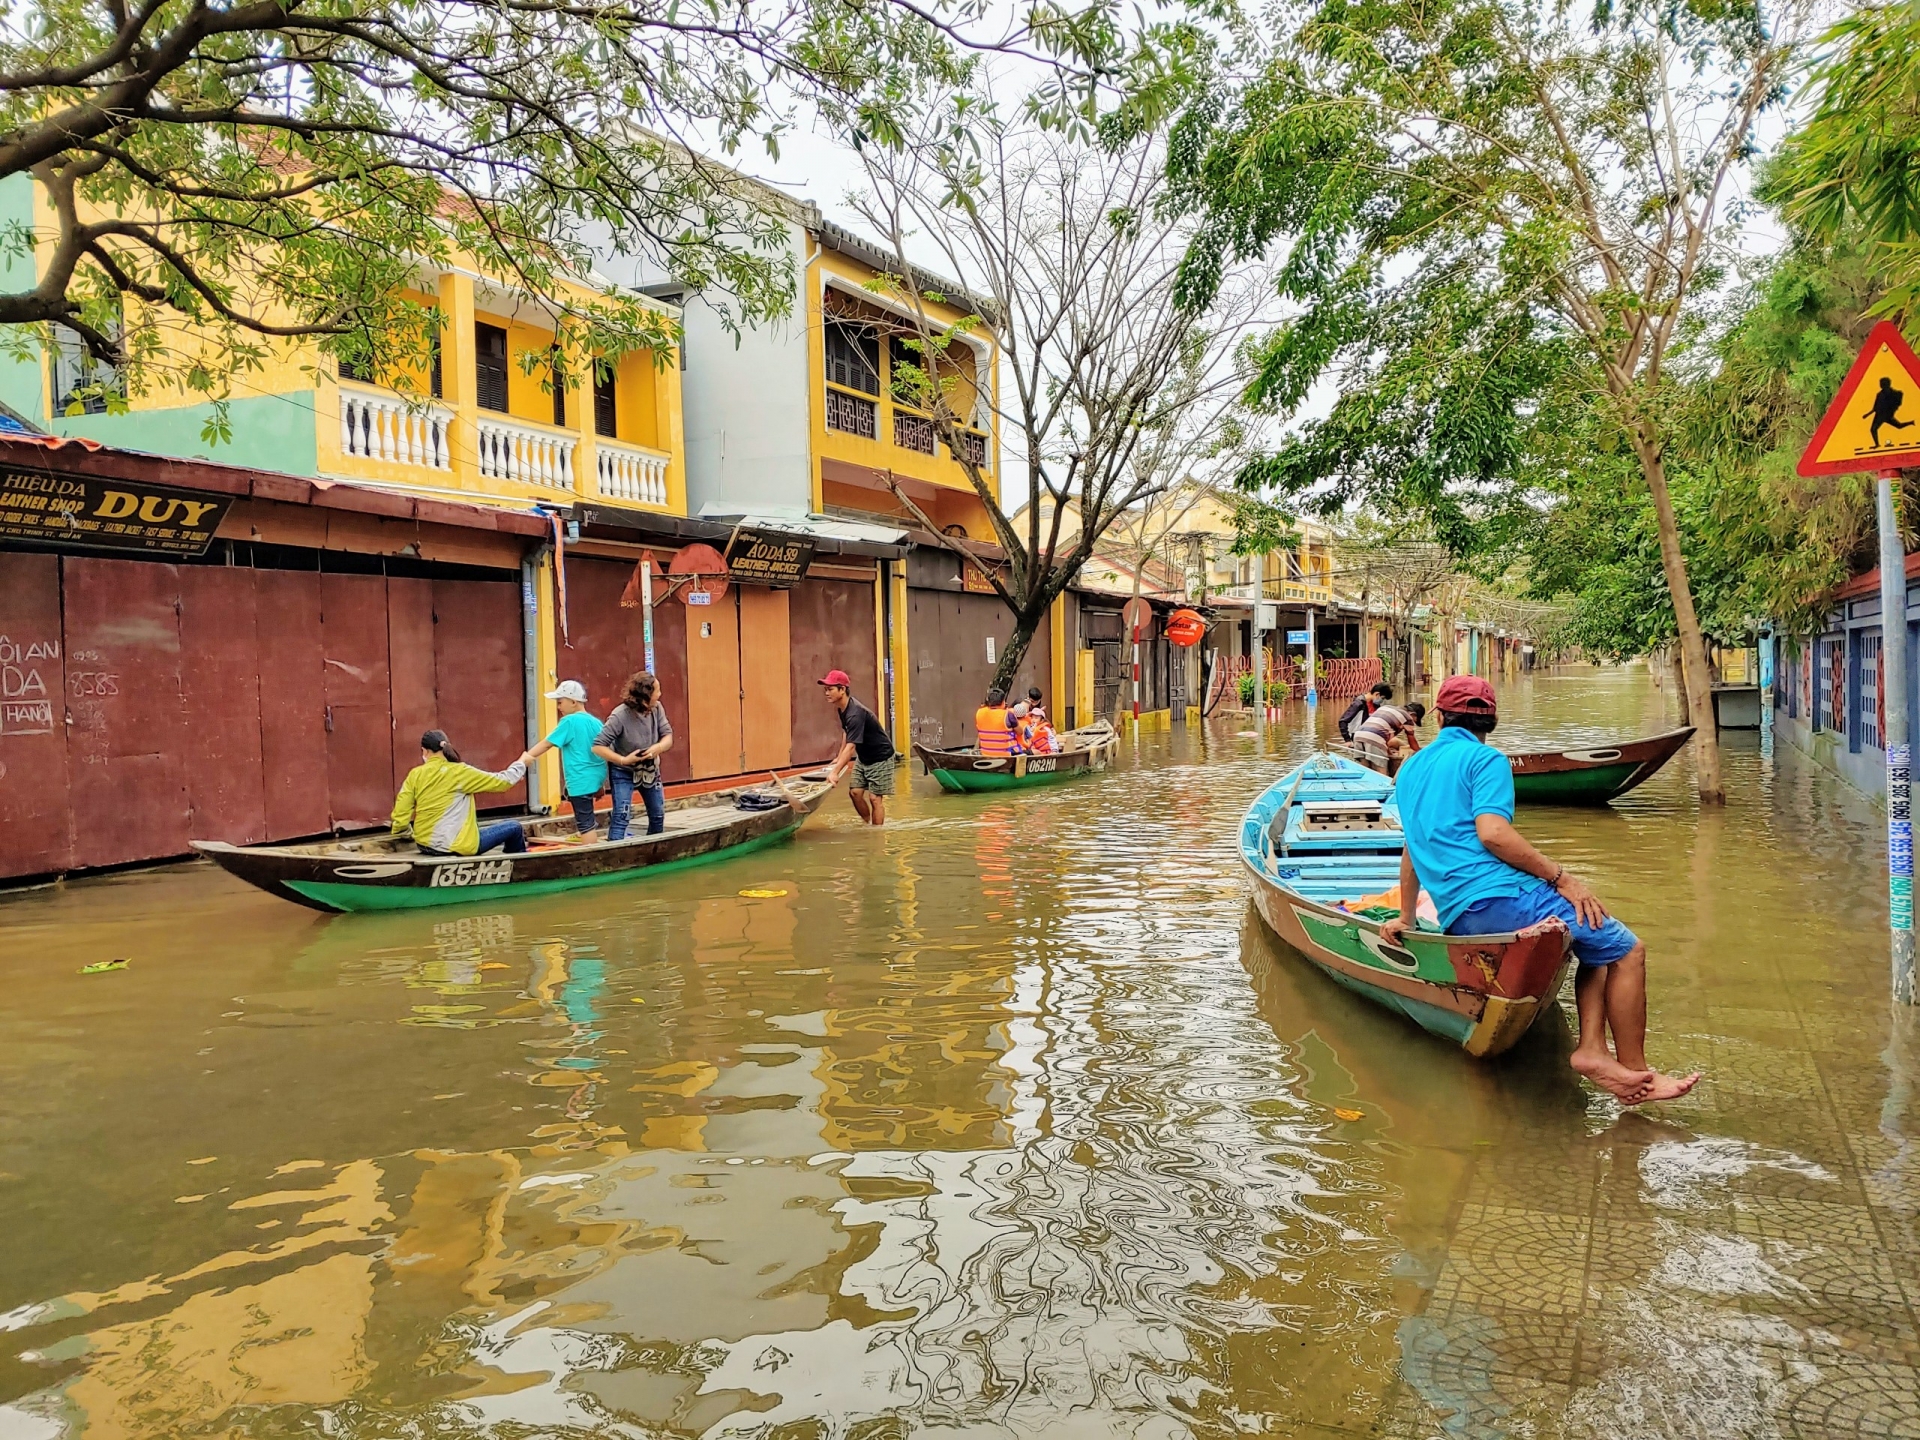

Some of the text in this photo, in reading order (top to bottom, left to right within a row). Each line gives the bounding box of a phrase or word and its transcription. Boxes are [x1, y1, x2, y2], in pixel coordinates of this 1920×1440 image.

[3, 474, 86, 497] HIỆU DA
[48, 498, 85, 514] SHOP
[93, 490, 218, 527] DUY
[746, 538, 768, 559] ÁO
[765, 546, 784, 560] DA
[732, 557, 801, 574] LEATHER JACKET
[25, 640, 59, 660] AN
